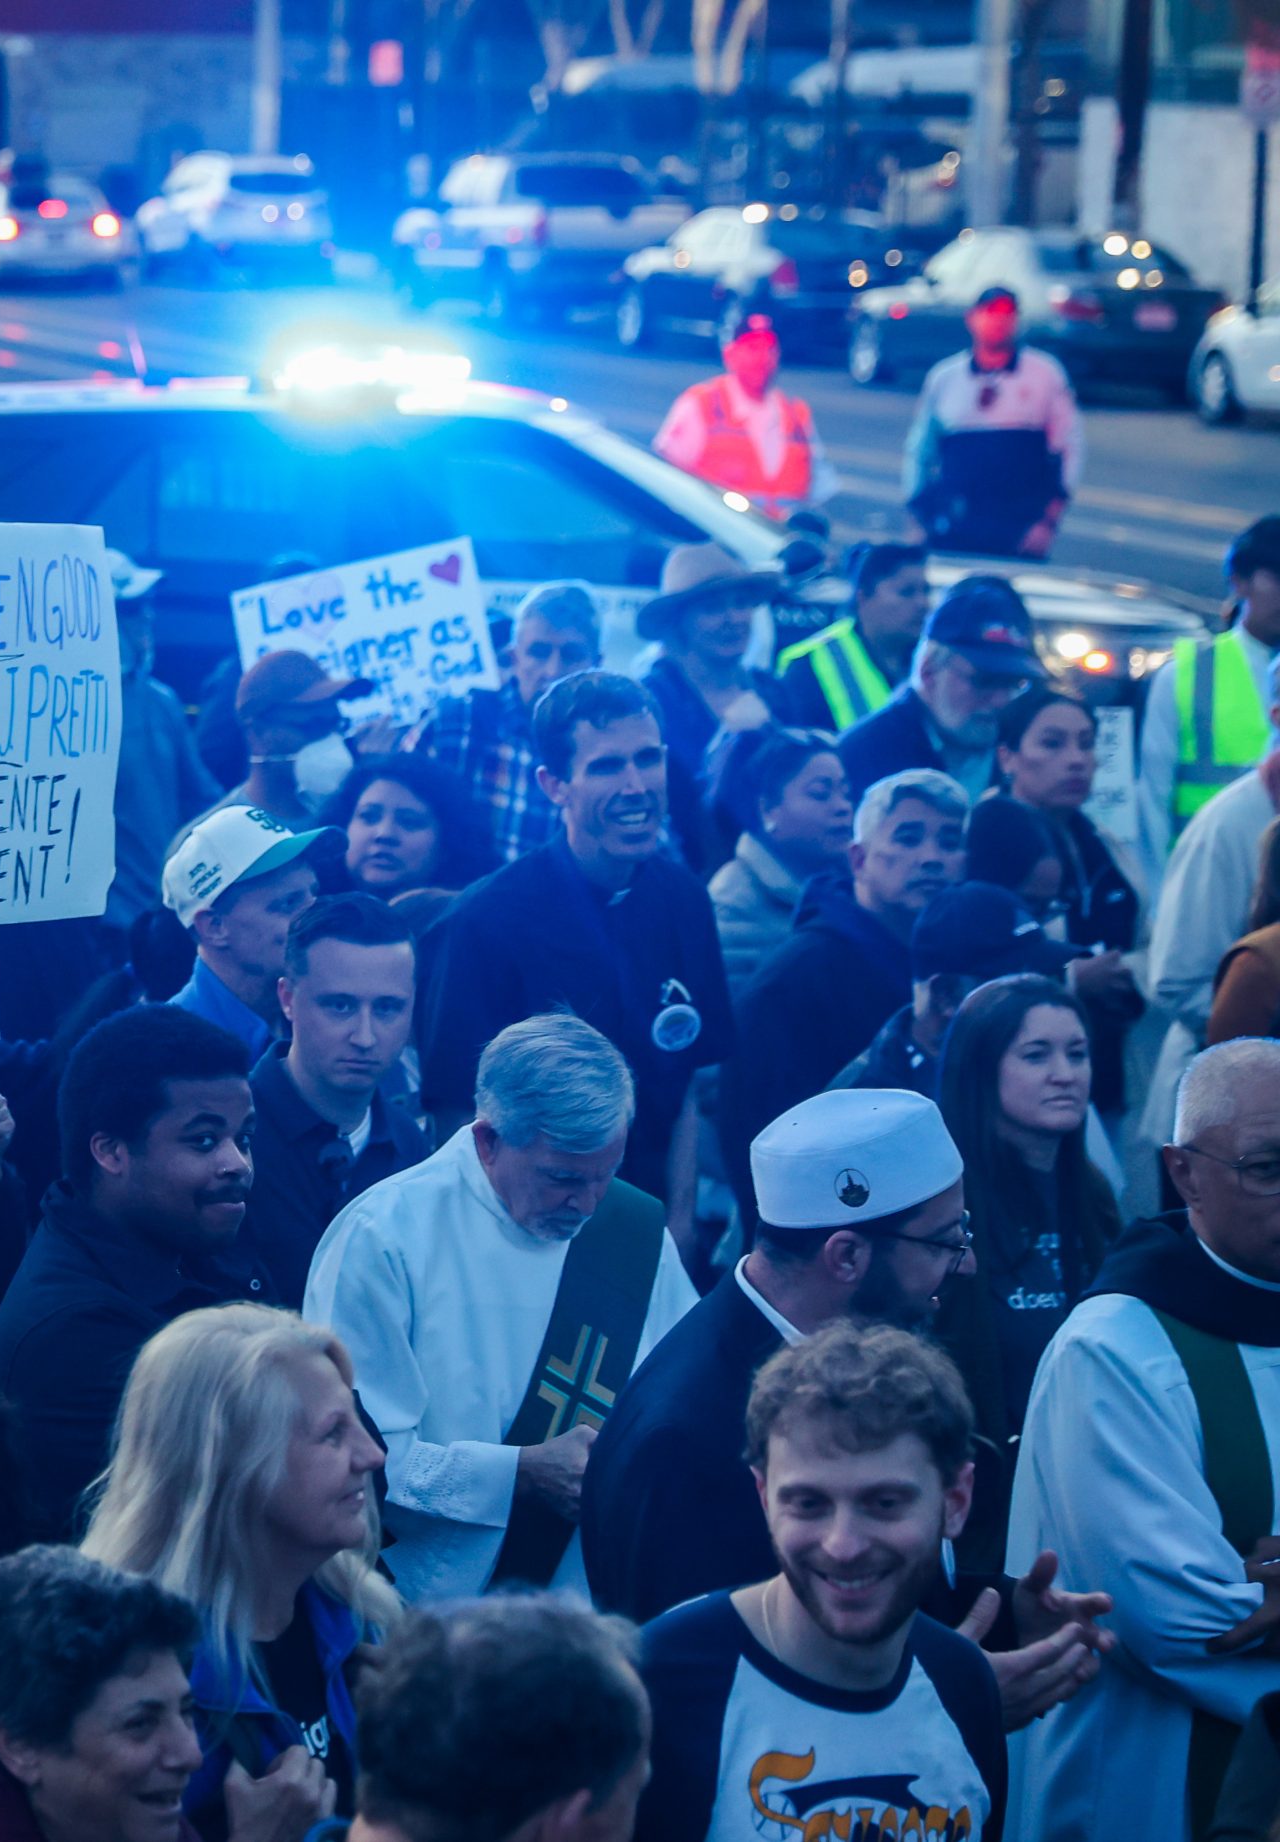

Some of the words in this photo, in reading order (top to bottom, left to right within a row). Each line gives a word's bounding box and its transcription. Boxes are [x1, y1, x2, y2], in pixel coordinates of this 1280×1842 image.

[43, 553, 101, 650] GOOD
[364, 567, 423, 609] the
[429, 615, 470, 646] as
[24, 664, 110, 763] PRETTI
